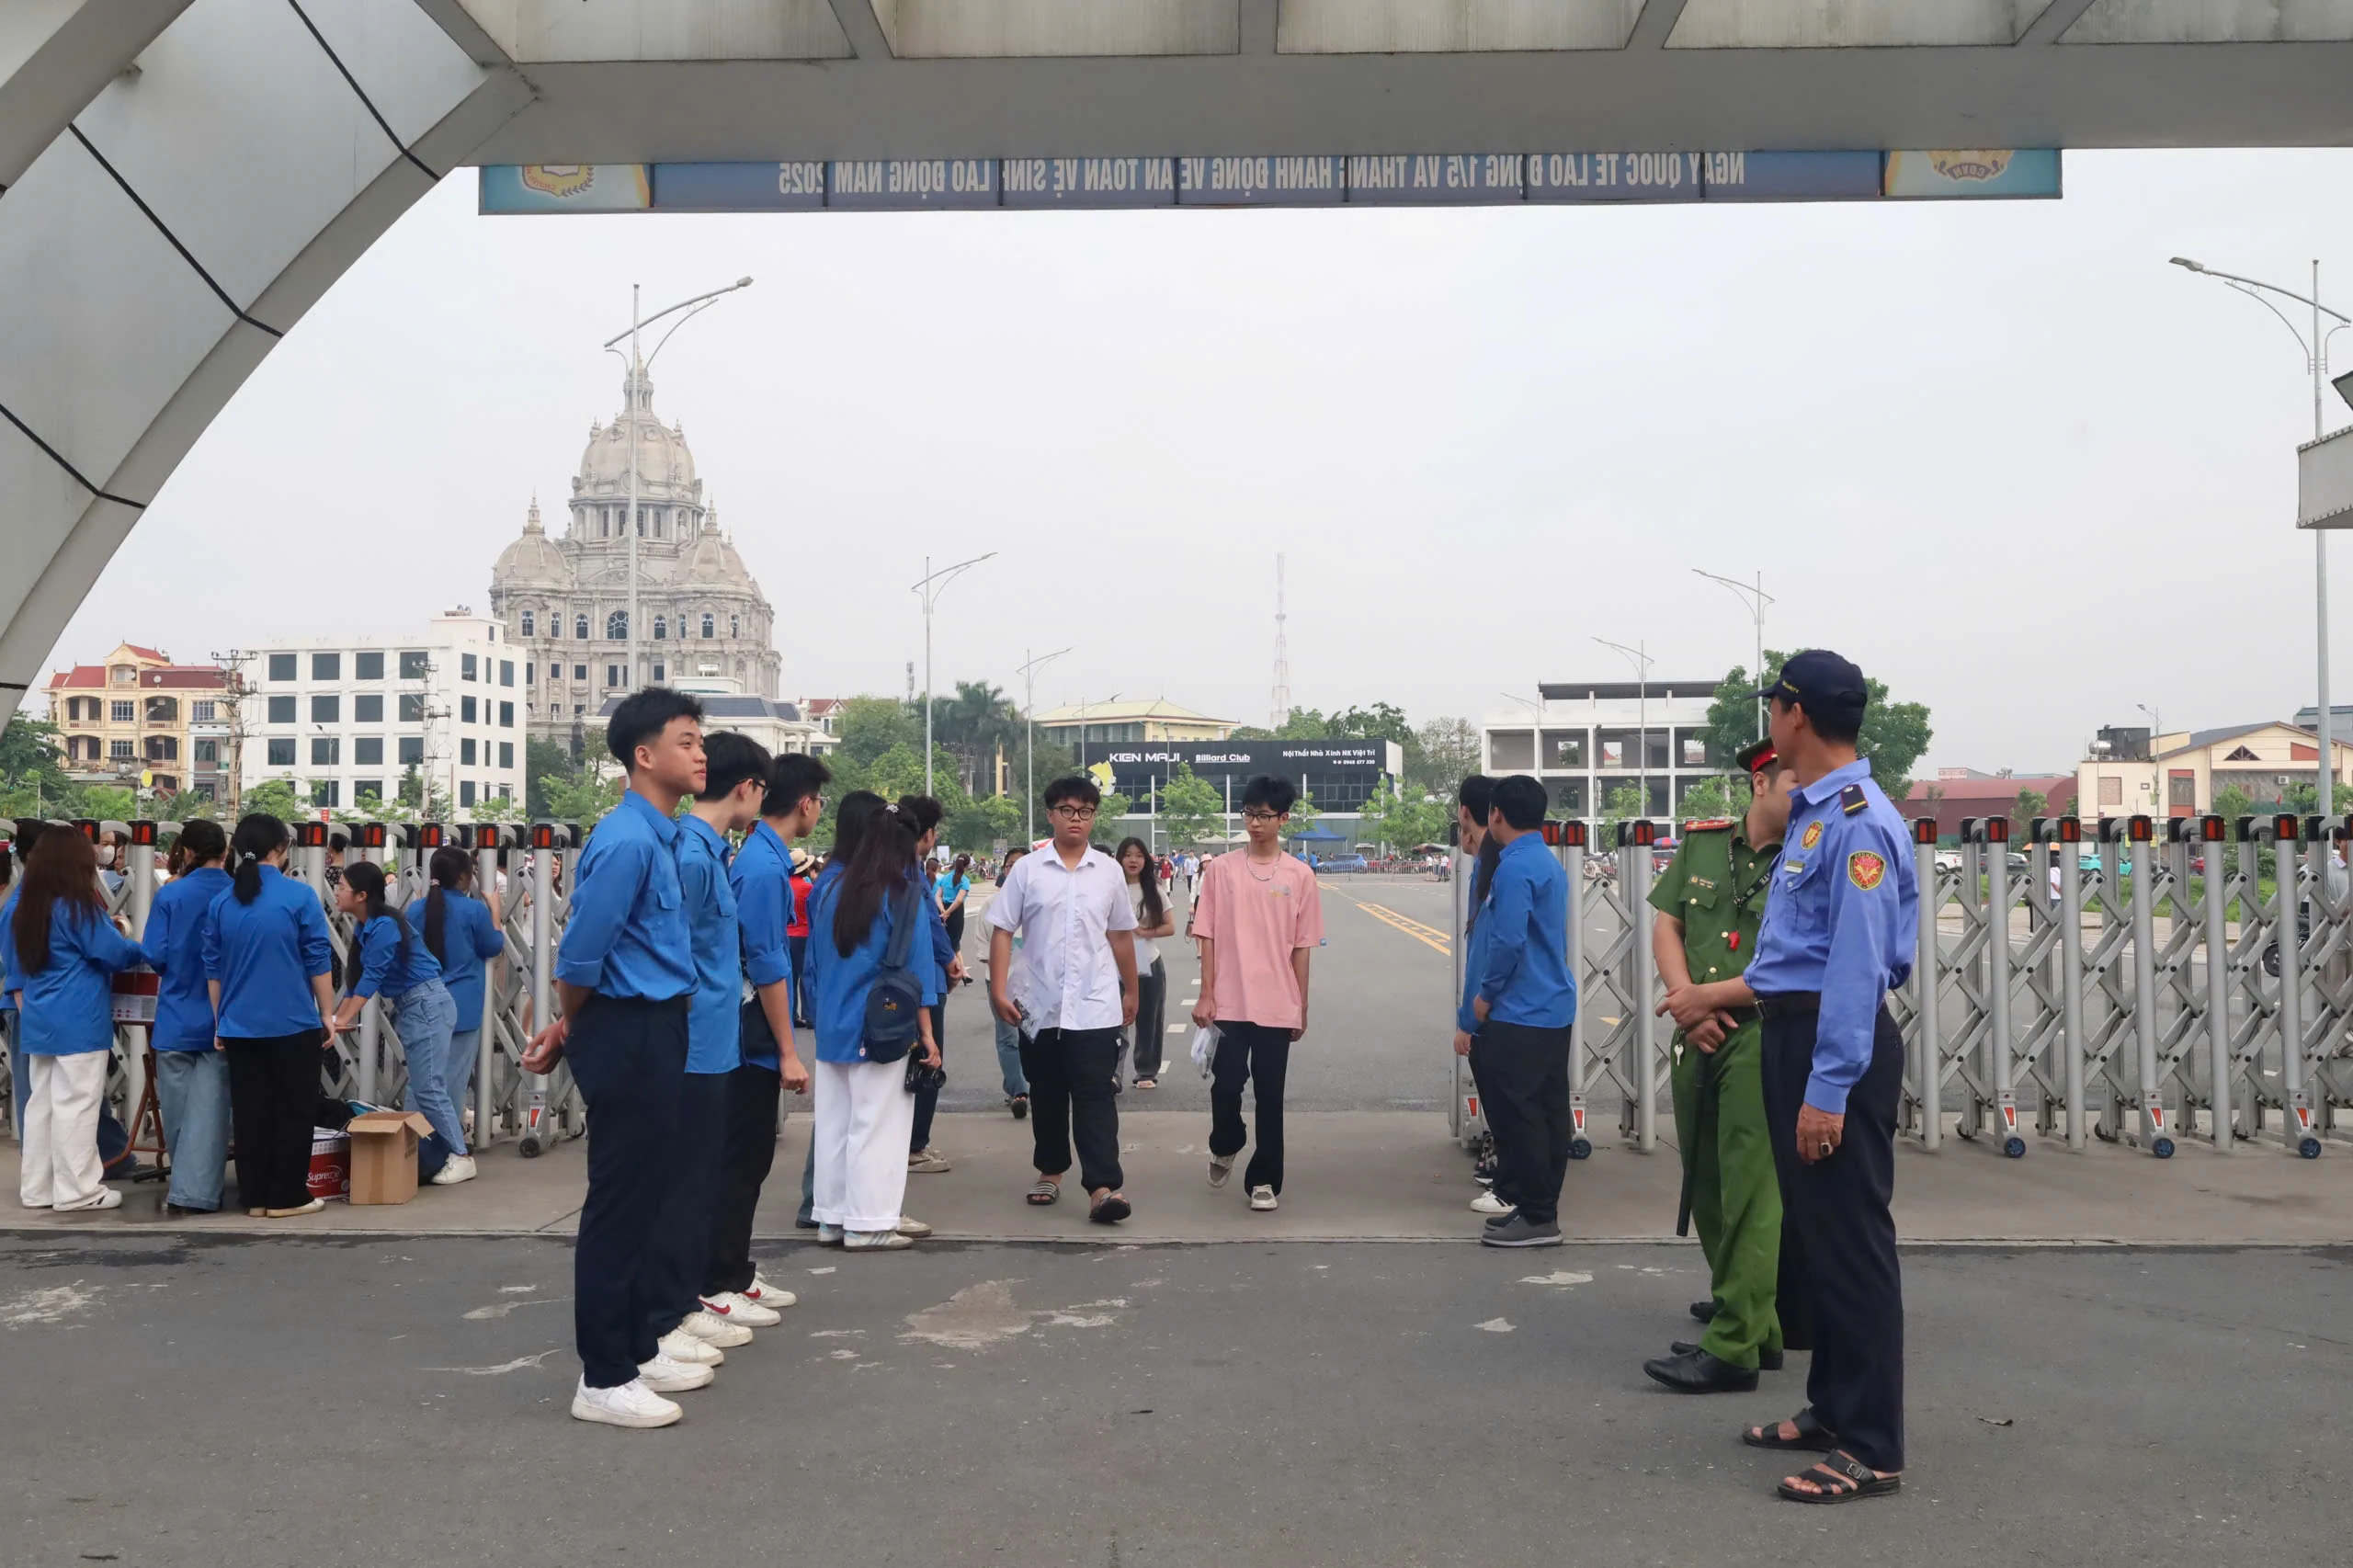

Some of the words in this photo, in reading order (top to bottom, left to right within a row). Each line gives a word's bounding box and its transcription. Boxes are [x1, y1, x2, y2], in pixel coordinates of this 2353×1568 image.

[1108, 753, 1142, 763] KIEN
[1145, 753, 1180, 763] MAJI
[1195, 754, 1226, 763] Billiard
[1228, 753, 1250, 763] Club
